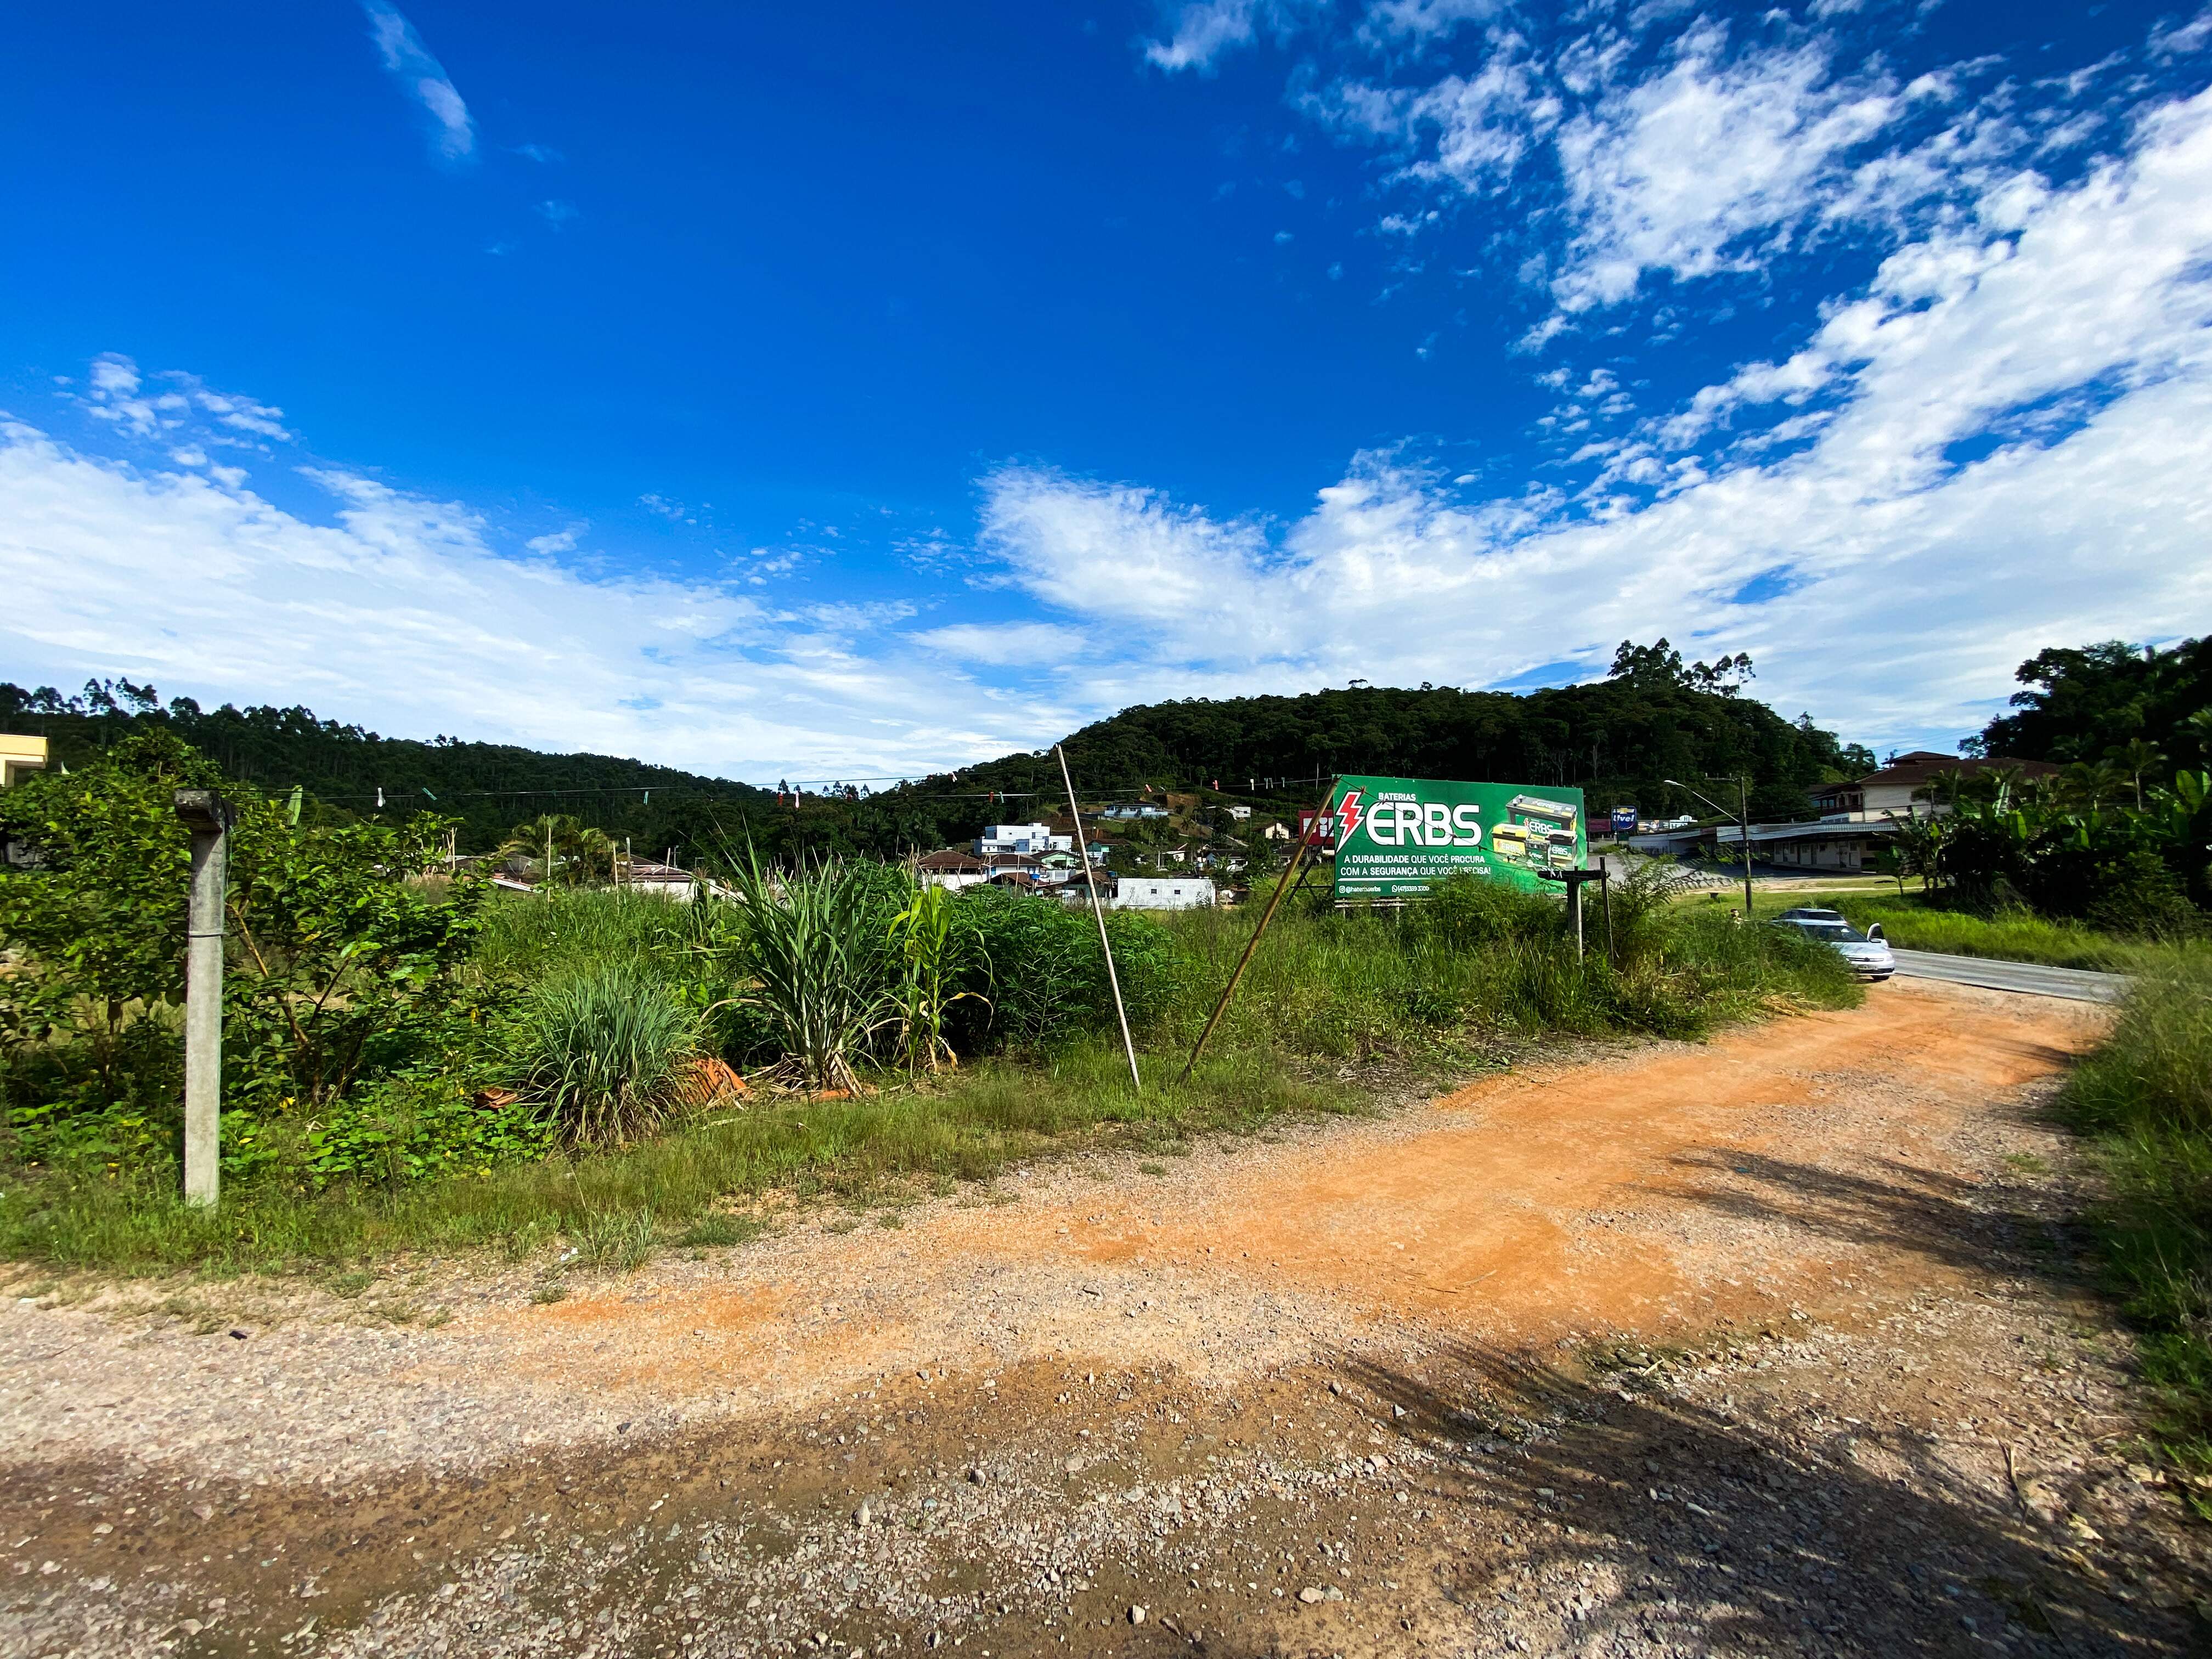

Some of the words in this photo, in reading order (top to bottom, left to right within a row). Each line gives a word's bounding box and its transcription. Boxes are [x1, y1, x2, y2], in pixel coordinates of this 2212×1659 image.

[1378, 792, 1416, 802] BATERIAS
[1366, 802, 1482, 846] ERBS
[1529, 821, 1553, 835] ERBS
[1551, 847, 1568, 855] ERBS
[1352, 855, 1409, 864] DURABILIDADE
[1411, 855, 1427, 864] QUE
[1429, 854, 1449, 864] VOCÊ
[1451, 855, 1485, 864] PROCURA
[1340, 867, 1359, 876] COM
[1362, 867, 1368, 876] A
[1370, 867, 1418, 877] SEGURANÇA
[1420, 866, 1436, 876] QUE
